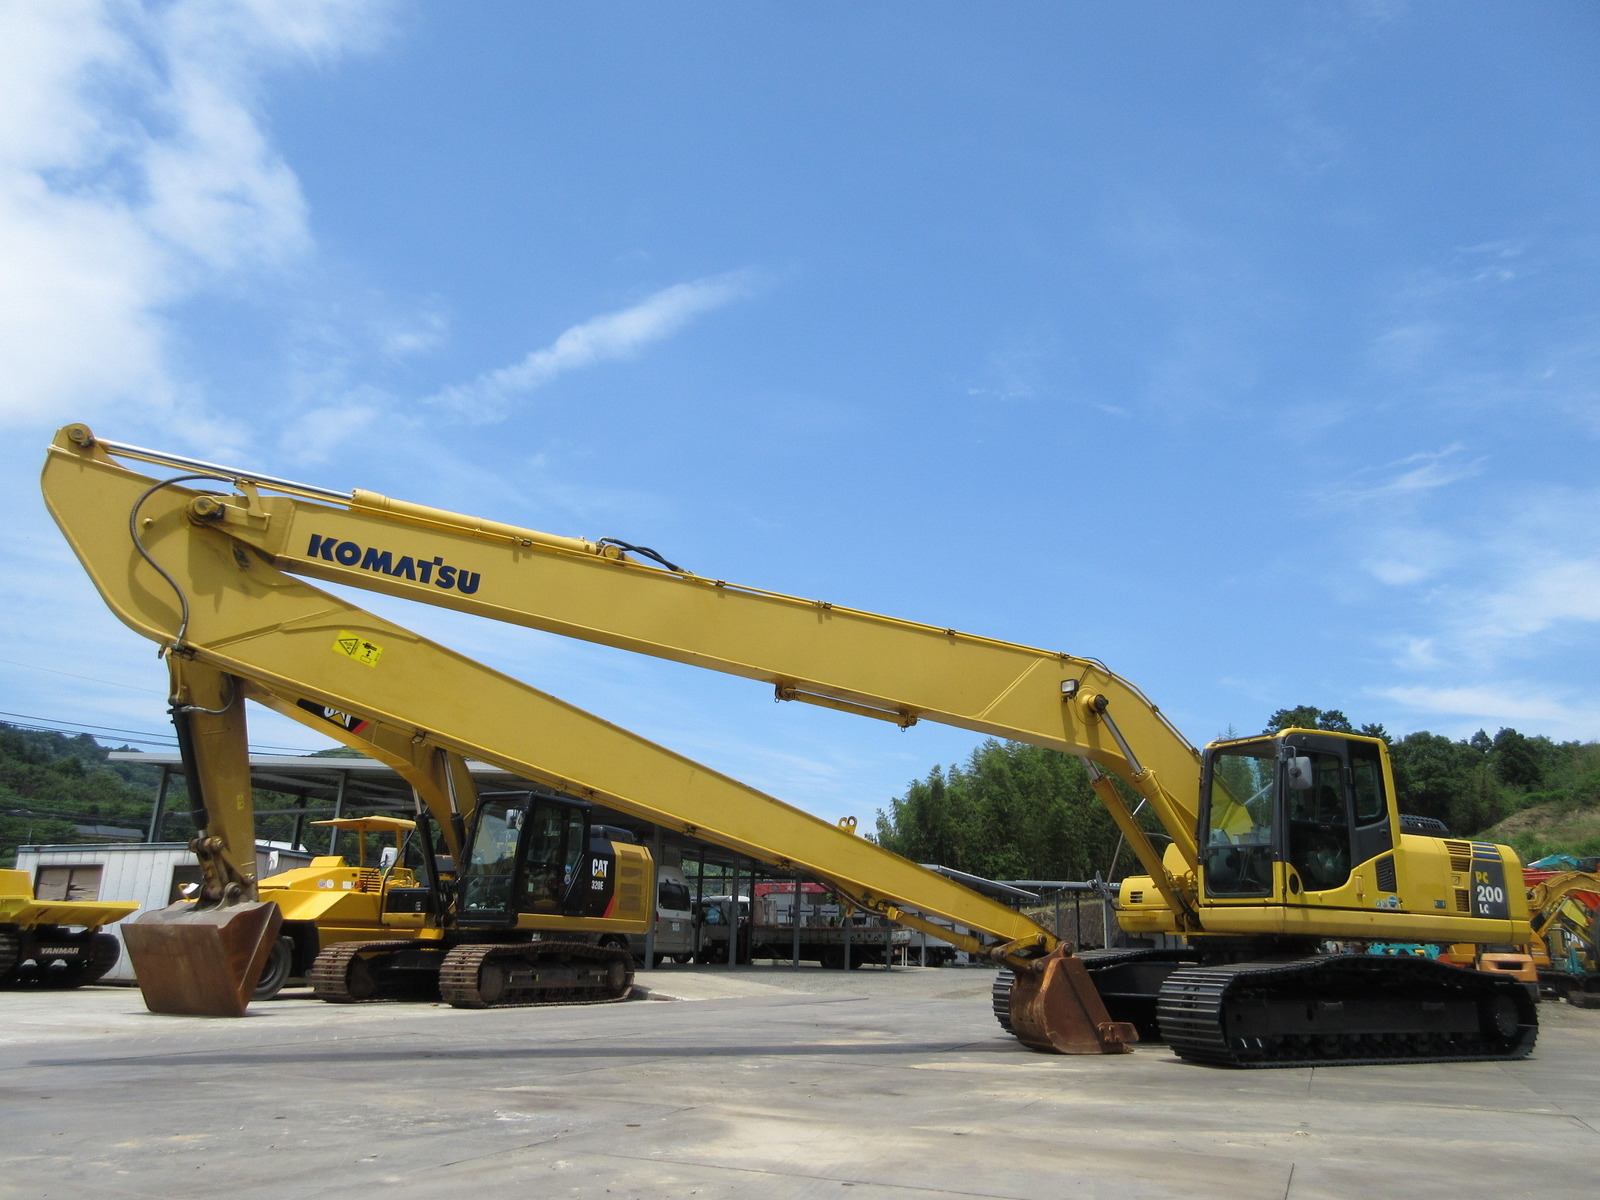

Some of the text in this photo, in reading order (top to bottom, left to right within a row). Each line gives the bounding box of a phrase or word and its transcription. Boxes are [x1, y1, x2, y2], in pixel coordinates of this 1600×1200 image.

[306, 533, 482, 595] KOMATSU
[592, 859, 608, 877] CAT
[1475, 870, 1489, 885] PC
[1477, 885, 1503, 903] 200
[1479, 903, 1490, 914] LC
[41, 947, 80, 955] YANMAR
